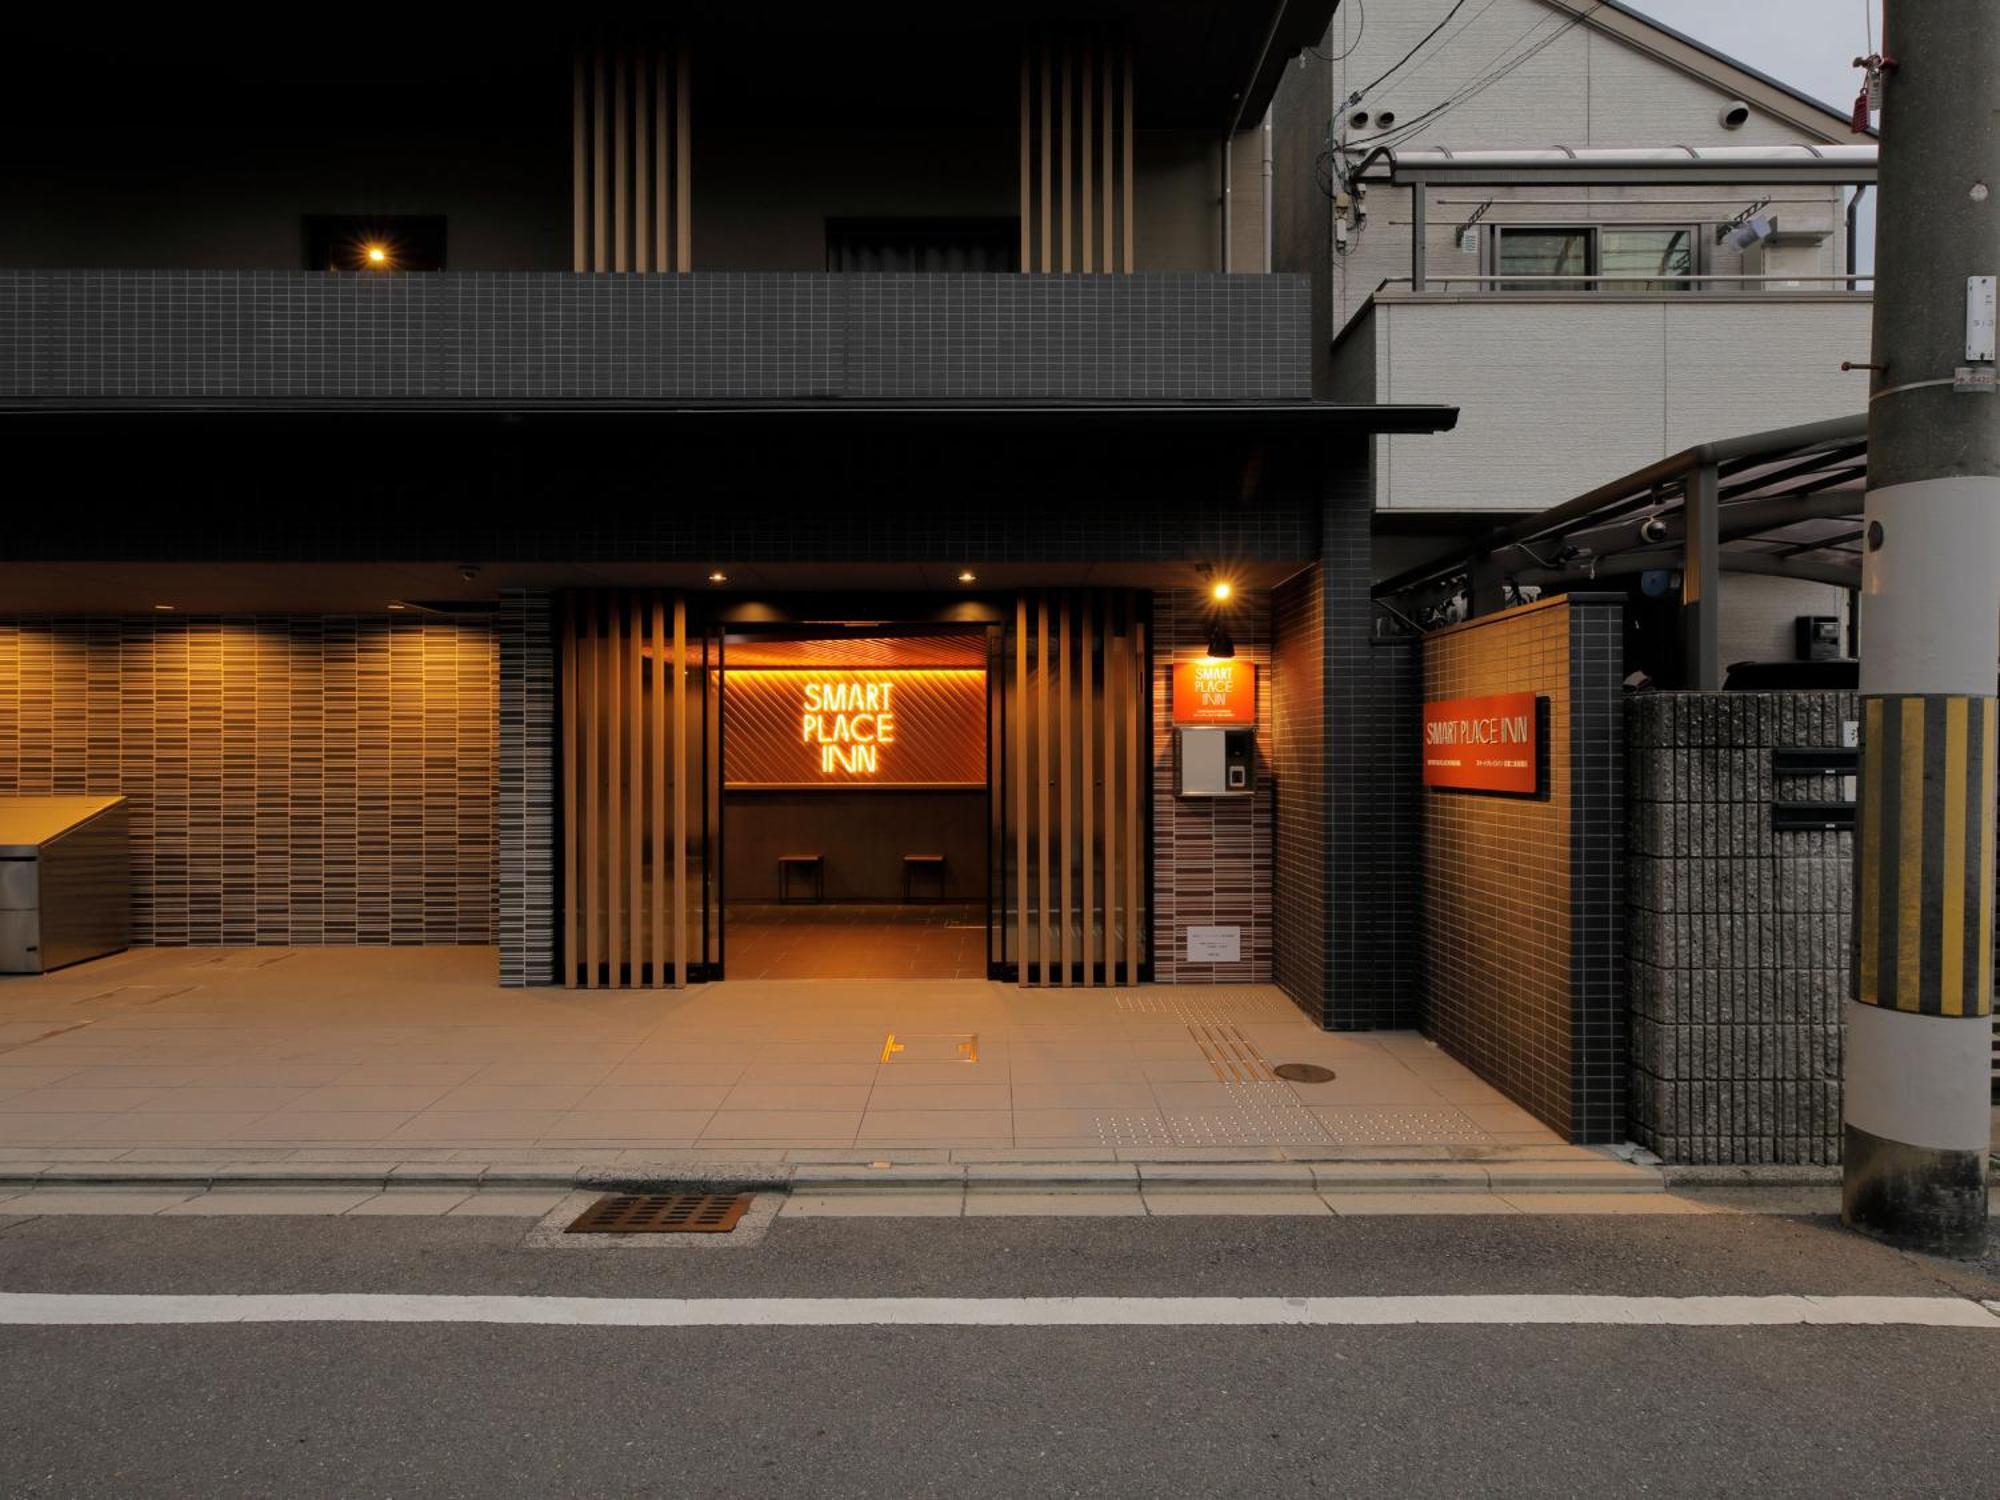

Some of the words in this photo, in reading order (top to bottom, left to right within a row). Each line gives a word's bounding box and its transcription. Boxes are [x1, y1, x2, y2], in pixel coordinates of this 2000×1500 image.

[1195, 667, 1233, 680] SMART
[1195, 681, 1233, 693] PLACE
[803, 683, 894, 713] SMART
[1202, 693, 1226, 705] INN
[803, 714, 894, 743] PLACE
[1426, 720, 1458, 745] SMART
[1460, 718, 1498, 744] PLACE
[1501, 716, 1527, 744] INN
[821, 744, 877, 774] INN
